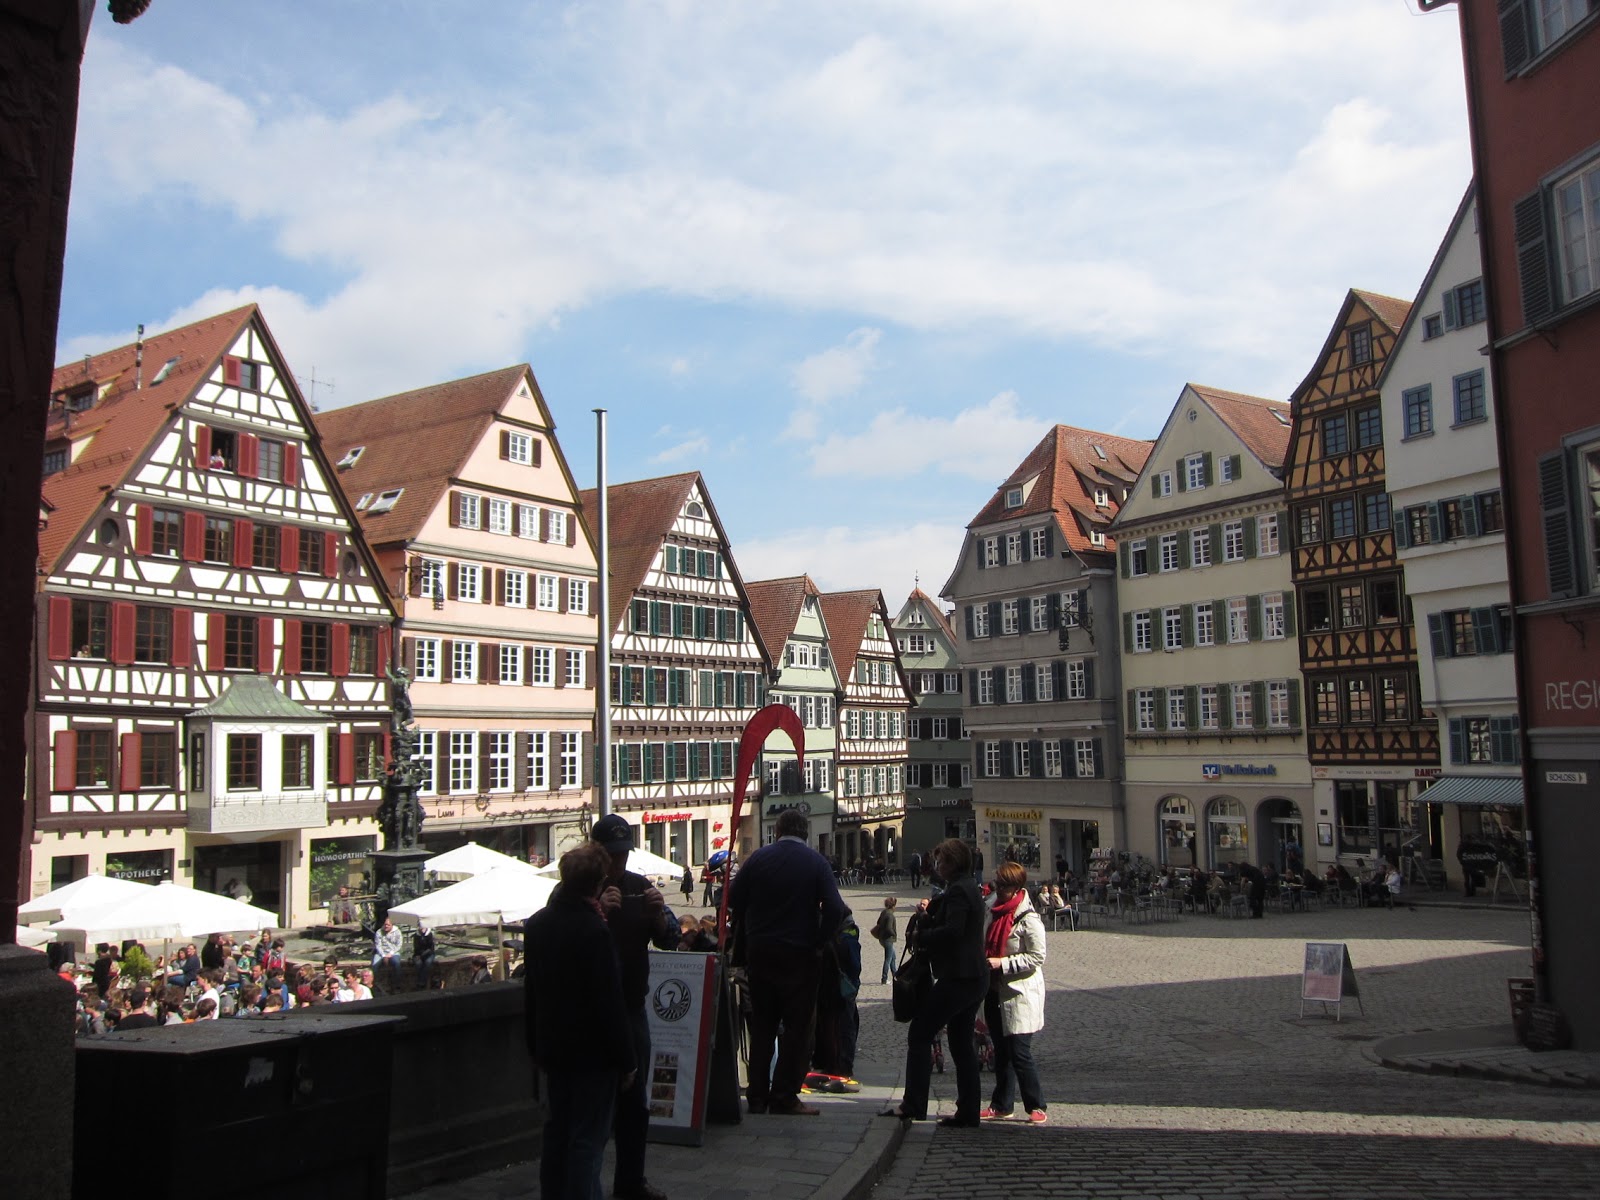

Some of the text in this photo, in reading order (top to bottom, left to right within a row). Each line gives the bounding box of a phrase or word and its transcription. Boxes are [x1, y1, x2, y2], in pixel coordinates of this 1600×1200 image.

[1545, 680, 1600, 710] REGI
[1221, 764, 1276, 775] Volksbank
[1548, 773, 1577, 783] SCHLOSS
[114, 868, 162, 879] APOTHEKE
